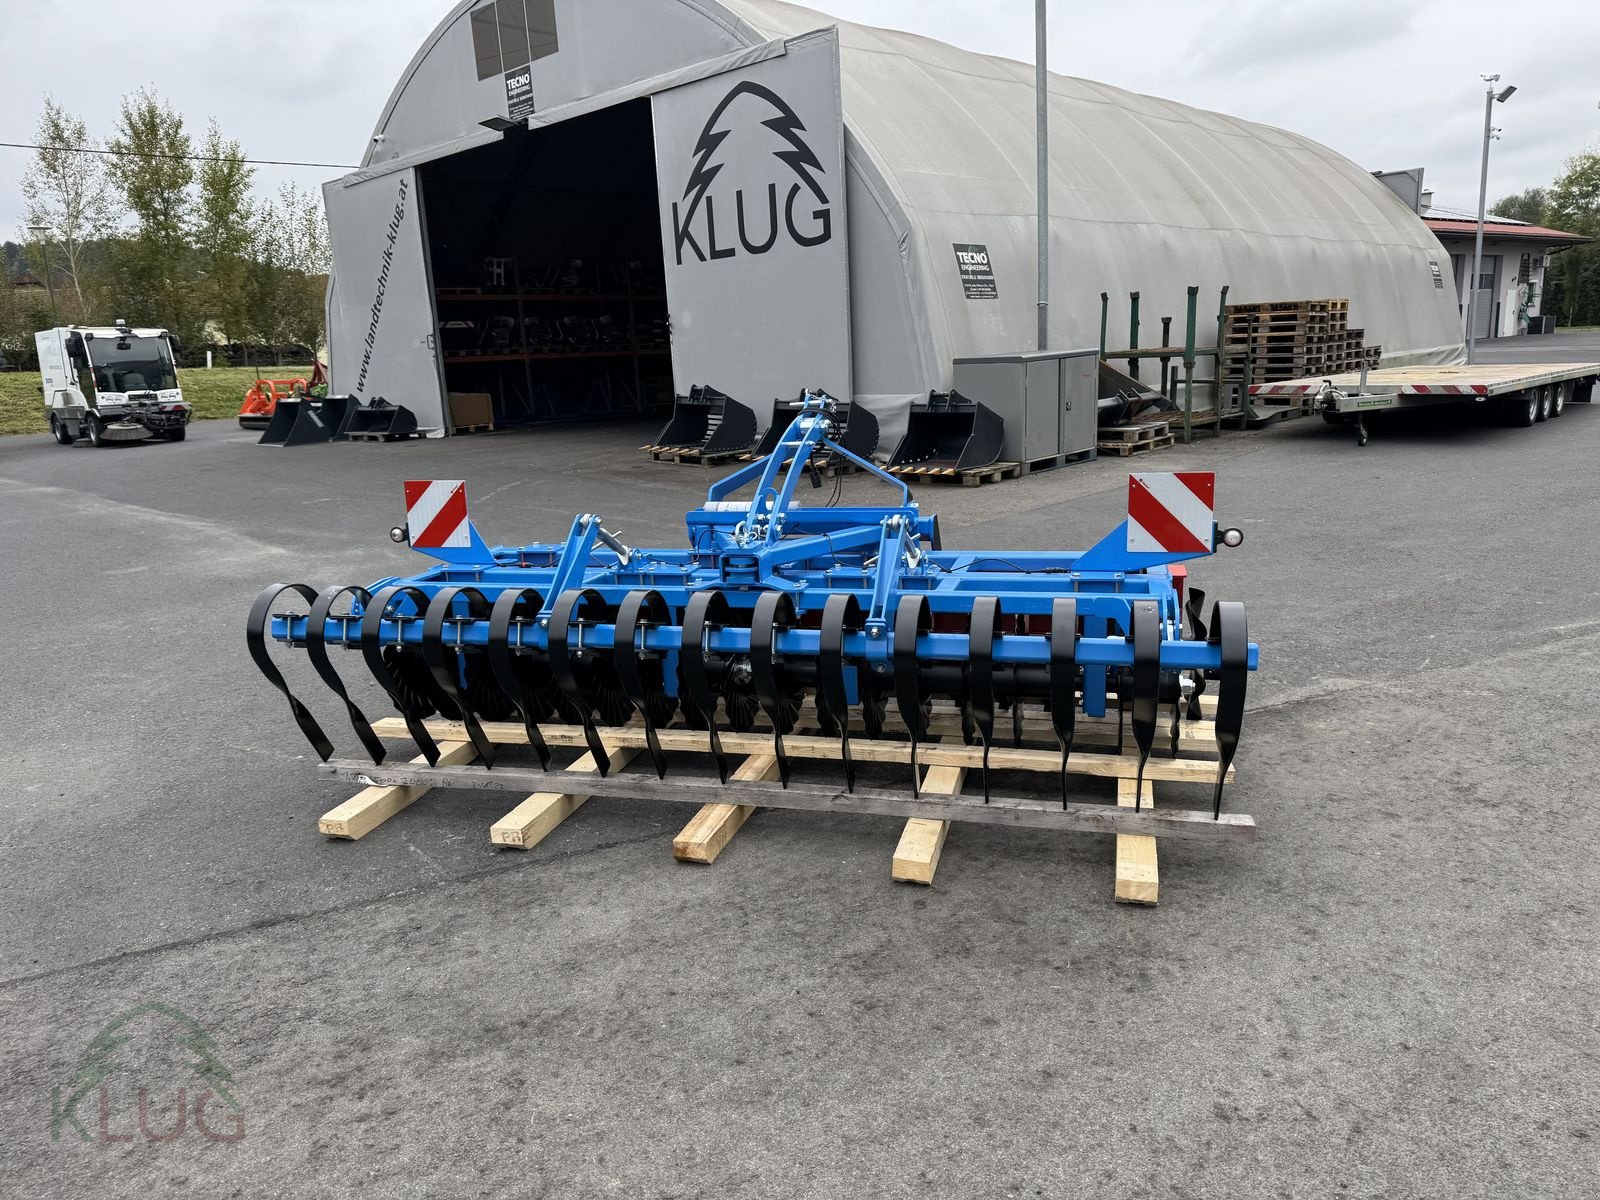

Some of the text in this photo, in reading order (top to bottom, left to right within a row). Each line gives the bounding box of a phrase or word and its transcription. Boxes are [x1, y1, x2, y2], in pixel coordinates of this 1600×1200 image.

[506, 73, 530, 90] TECNO
[671, 182, 832, 266] KLUG
[956, 251, 988, 264] TECNO
[356, 178, 409, 393] www.landtechnik-klug.at
